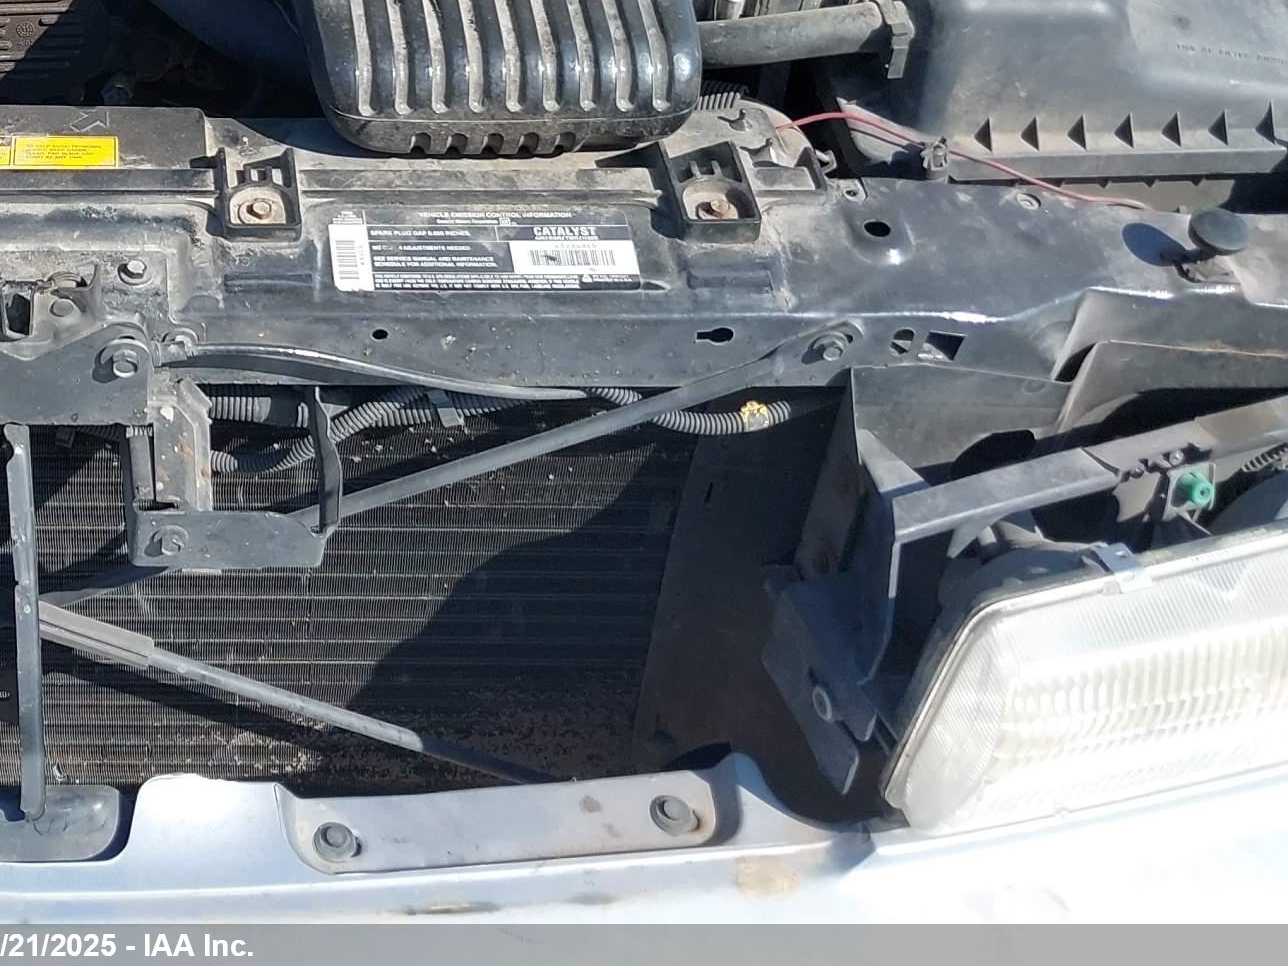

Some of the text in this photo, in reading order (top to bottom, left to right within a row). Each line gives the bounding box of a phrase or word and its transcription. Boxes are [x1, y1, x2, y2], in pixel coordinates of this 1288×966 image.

[486, 211, 521, 219] CONTROL
[522, 211, 573, 219] INFORMATION
[533, 226, 597, 236] CATALYST
